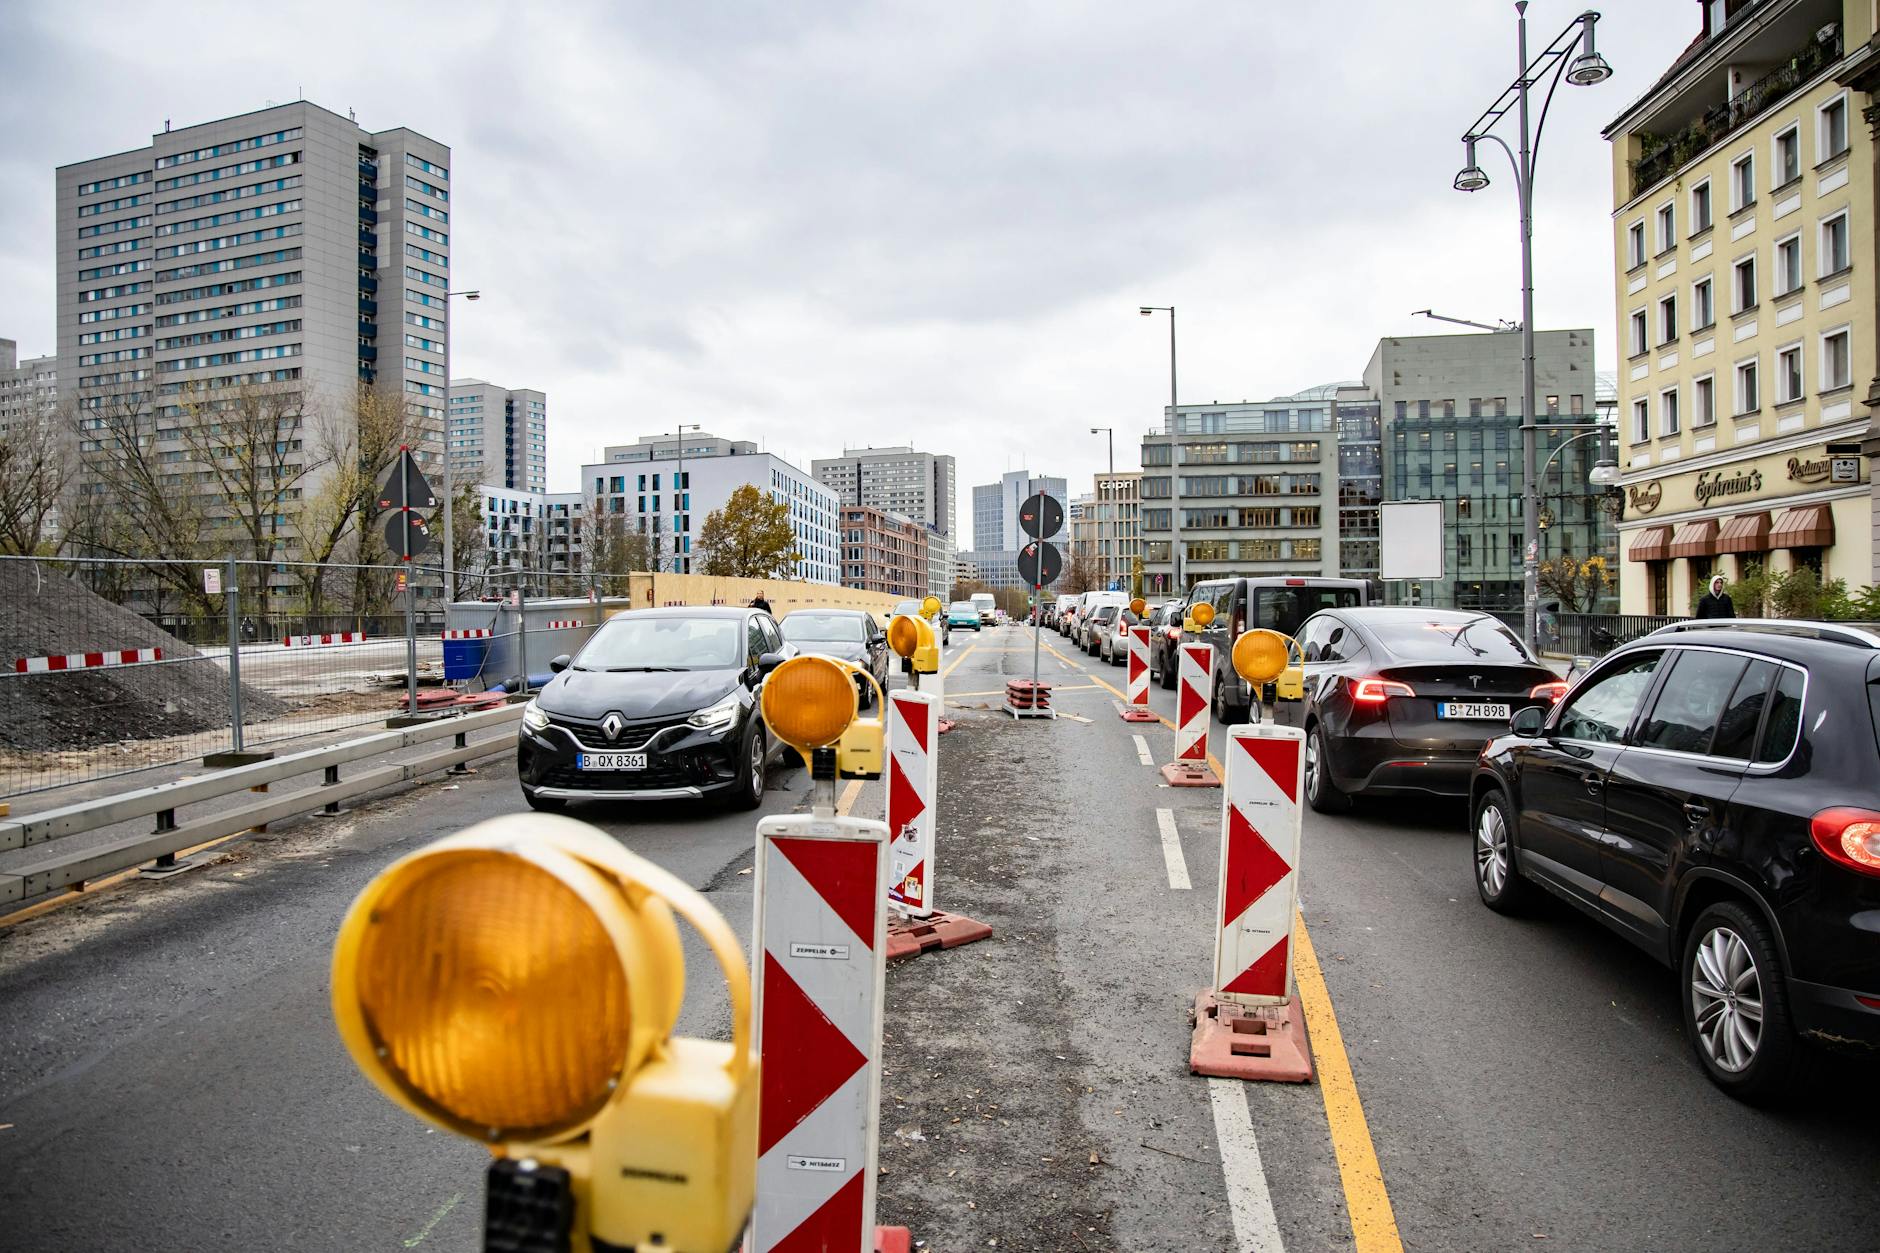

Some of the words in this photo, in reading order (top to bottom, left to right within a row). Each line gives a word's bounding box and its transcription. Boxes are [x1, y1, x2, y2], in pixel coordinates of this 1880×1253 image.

[1450, 704, 1457, 716] B
[1465, 704, 1481, 716] ZH
[1483, 705, 1505, 717] 898
[583, 755, 591, 767] B
[598, 755, 613, 767] QX
[616, 755, 645, 767] 8361
